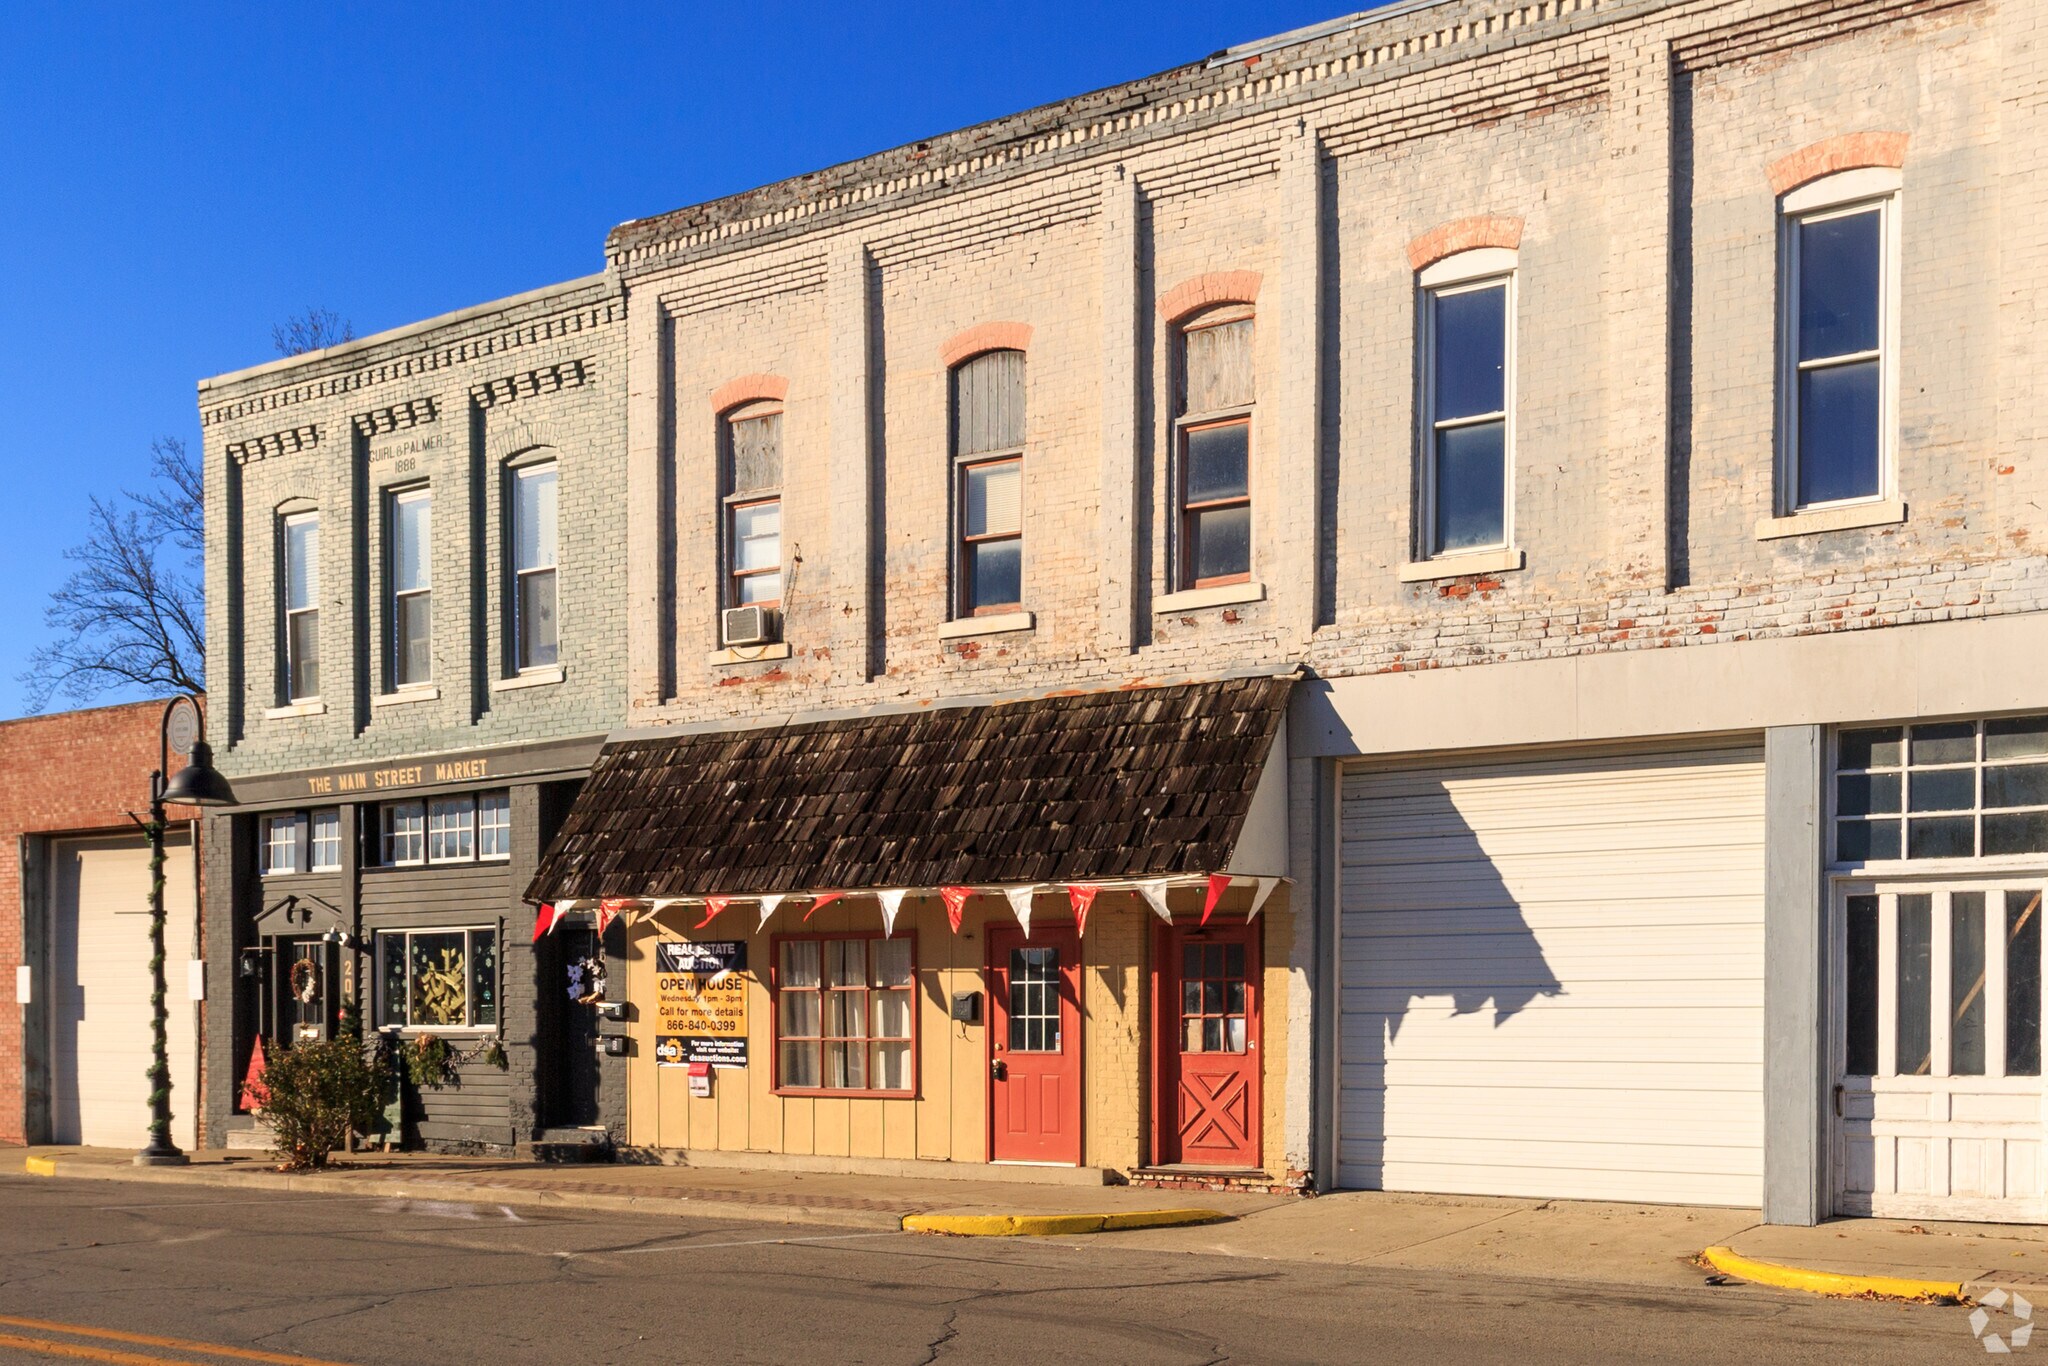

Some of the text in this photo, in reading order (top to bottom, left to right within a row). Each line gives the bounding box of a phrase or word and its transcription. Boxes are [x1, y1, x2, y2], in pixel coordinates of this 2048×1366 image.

[404, 434, 443, 455] PALMER
[395, 457, 416, 474] 1888
[308, 759, 487, 794] THE MAIN STREET MARKET
[667, 943, 736, 956] REAL ESTATE
[678, 957, 724, 970] AUCTION
[660, 978, 742, 990] OPEN HOUSE
[660, 995, 700, 1003] Wednesday
[704, 995, 718, 1003] 1pm
[726, 995, 742, 1003] 3pm
[660, 1007, 674, 1016] Call
[677, 1007, 688, 1016] for
[715, 1008, 743, 1017] details
[667, 1020, 736, 1031] 866-840-0399
[657, 1044, 676, 1056] dsa
[689, 1053, 746, 1063] dsaauctions.com
